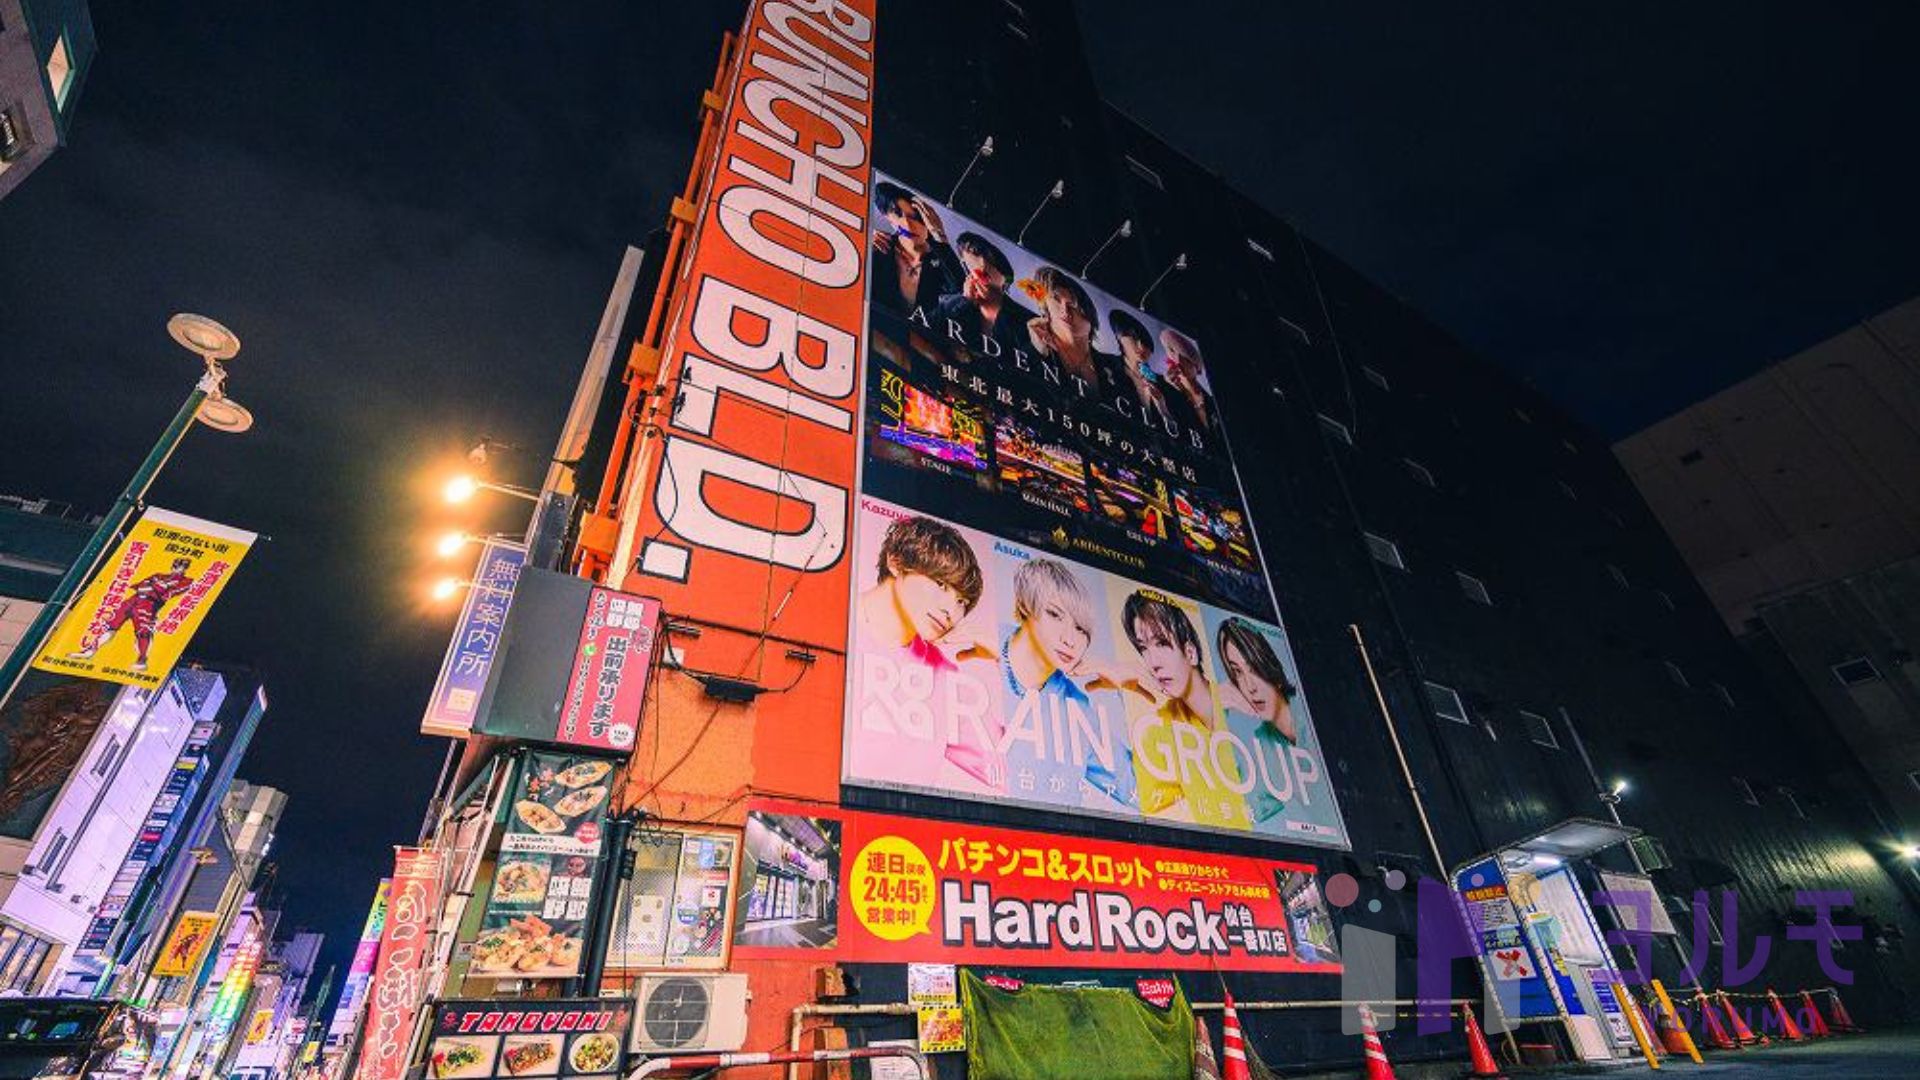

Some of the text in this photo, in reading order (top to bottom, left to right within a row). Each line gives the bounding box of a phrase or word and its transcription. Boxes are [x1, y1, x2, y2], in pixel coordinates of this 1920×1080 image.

[636, 0, 873, 584] BUNCHO BLD.
[908, 303, 1204, 450] ARDENT CLUB
[453, 557, 520, 678] 無料案内所
[588, 635, 629, 738] 出前承ります
[944, 669, 1319, 807] RAIN GROUP
[937, 837, 1152, 889] パチンコ&スロット
